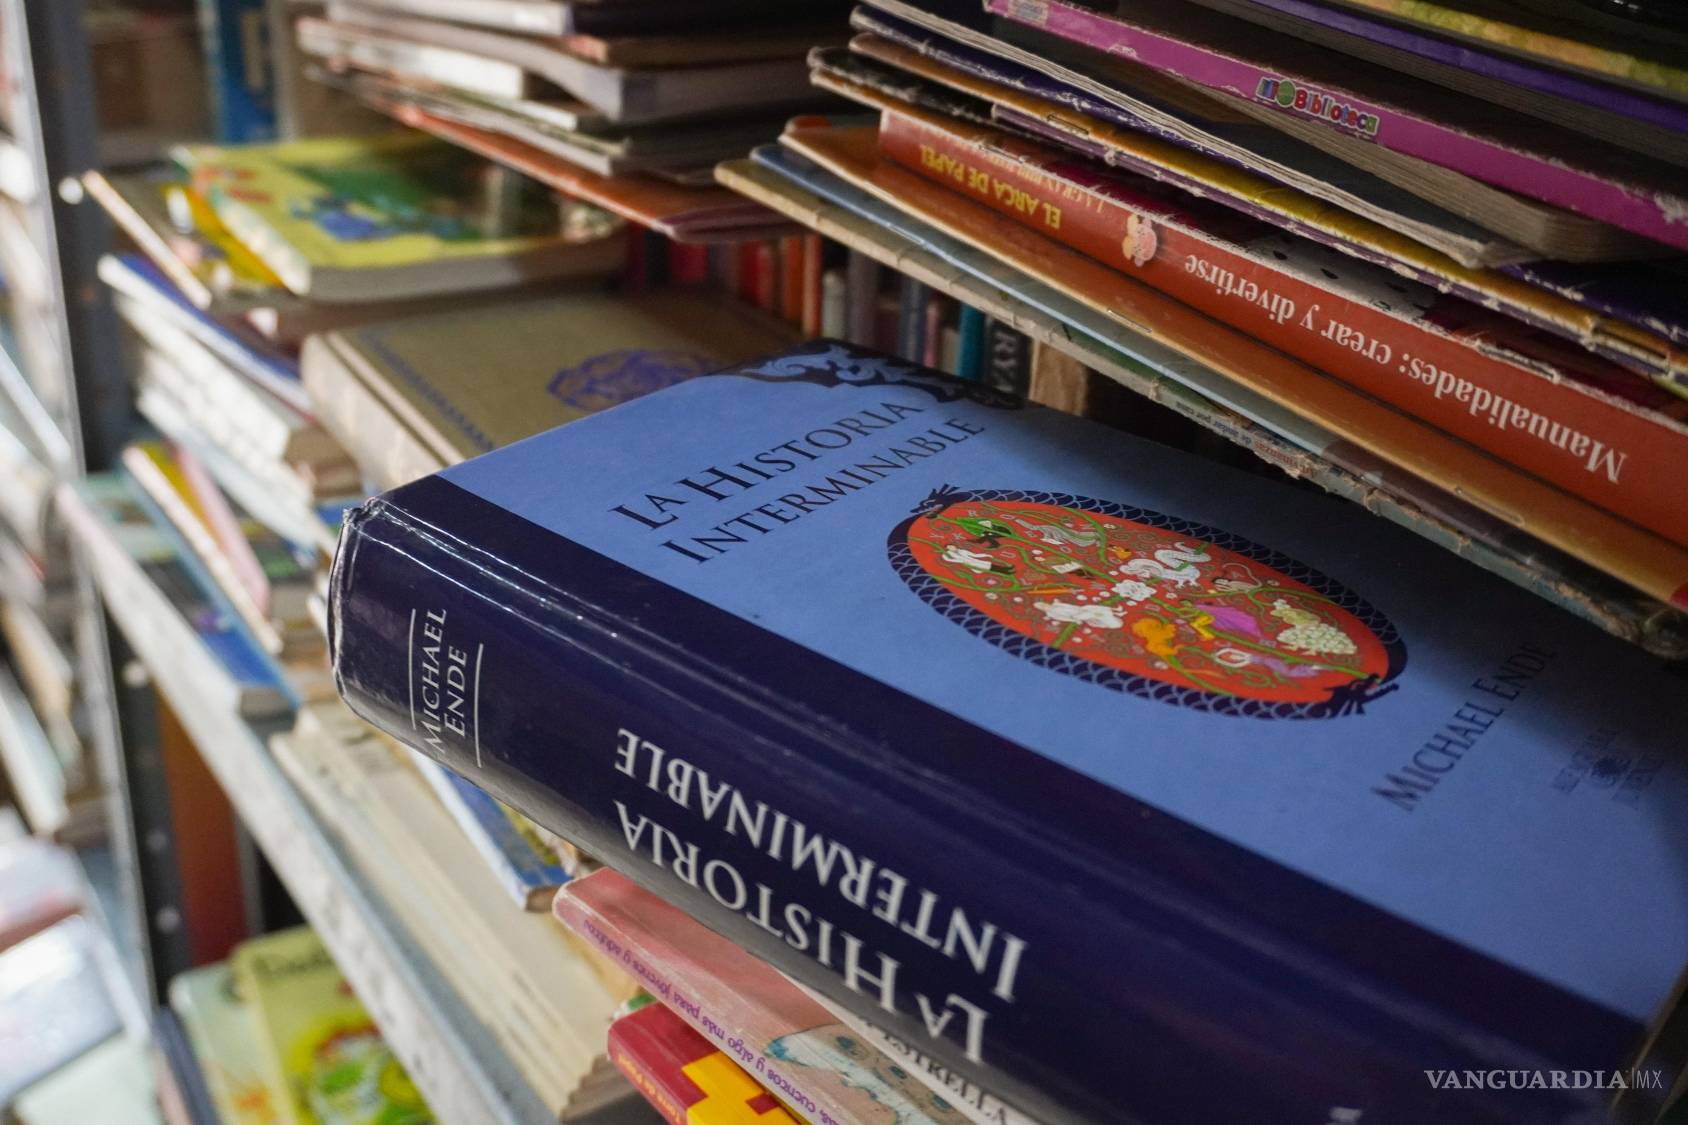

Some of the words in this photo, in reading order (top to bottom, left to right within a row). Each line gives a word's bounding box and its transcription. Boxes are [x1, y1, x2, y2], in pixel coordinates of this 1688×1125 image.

[920, 144, 964, 182] PAPEL
[967, 165, 990, 193] DE
[992, 178, 1040, 215] ARCA
[1043, 204, 1062, 229] EL
[1184, 254, 1296, 325] divertirse
[1299, 304, 1321, 330] y
[1320, 319, 1393, 366] crear
[1399, 352, 1629, 485] Manualidades:
[607, 491, 687, 532] LA
[674, 401, 926, 502] HISTORIA
[659, 417, 987, 565] INTERMINABLE
[421, 609, 448, 754] MICHAEL
[444, 645, 468, 738] ENDE
[1370, 702, 1505, 813] MICHAEL
[614, 727, 1030, 1002] INTERMINABLE
[612, 799, 901, 1016] HISTORIA
[673, 990, 701, 1020] para
[914, 991, 989, 1064] LA
[727, 1036, 754, 1064] algo
[754, 1056, 767, 1074] y
[766, 1068, 817, 1114] cuentos
